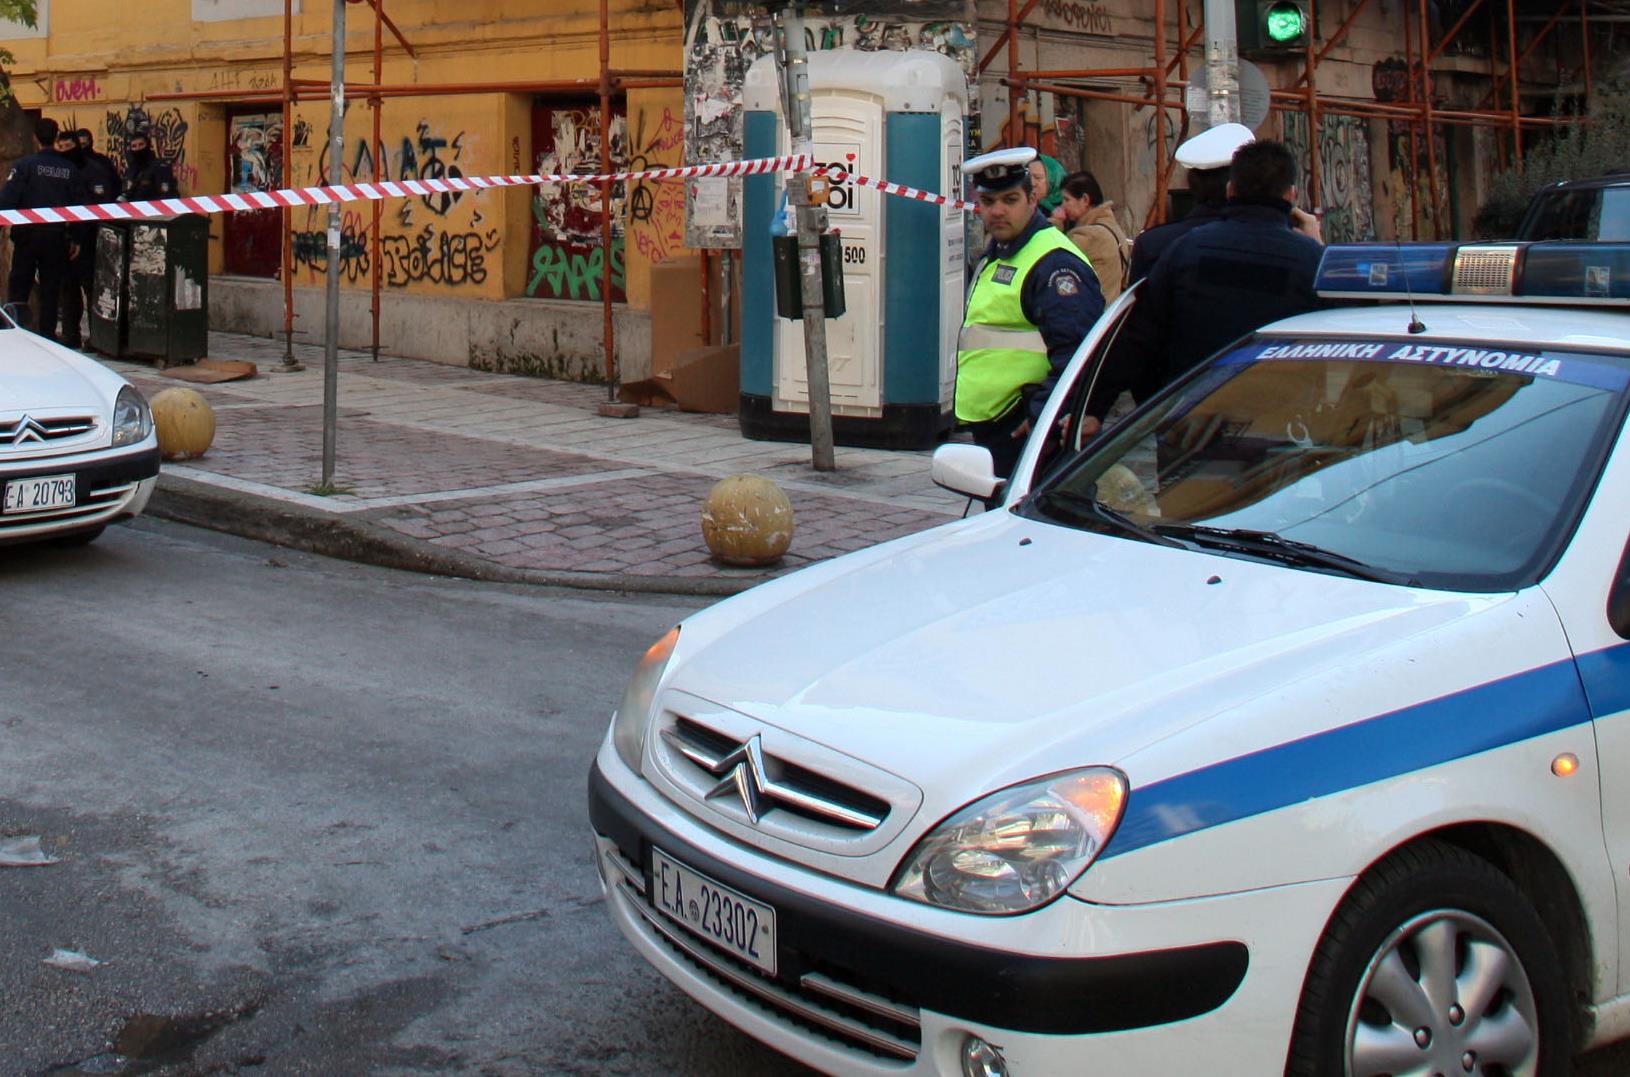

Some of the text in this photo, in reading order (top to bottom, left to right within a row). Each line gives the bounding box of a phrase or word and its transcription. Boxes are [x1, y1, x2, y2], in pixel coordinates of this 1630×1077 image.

[1255, 343, 1385, 360] ΕΛΛΗΝΙΚΗ
[1388, 345, 1562, 375] ΑΣΤΥΝΟΜΙΑ
[33, 480, 74, 505] 20793
[701, 884, 759, 959] 23302
